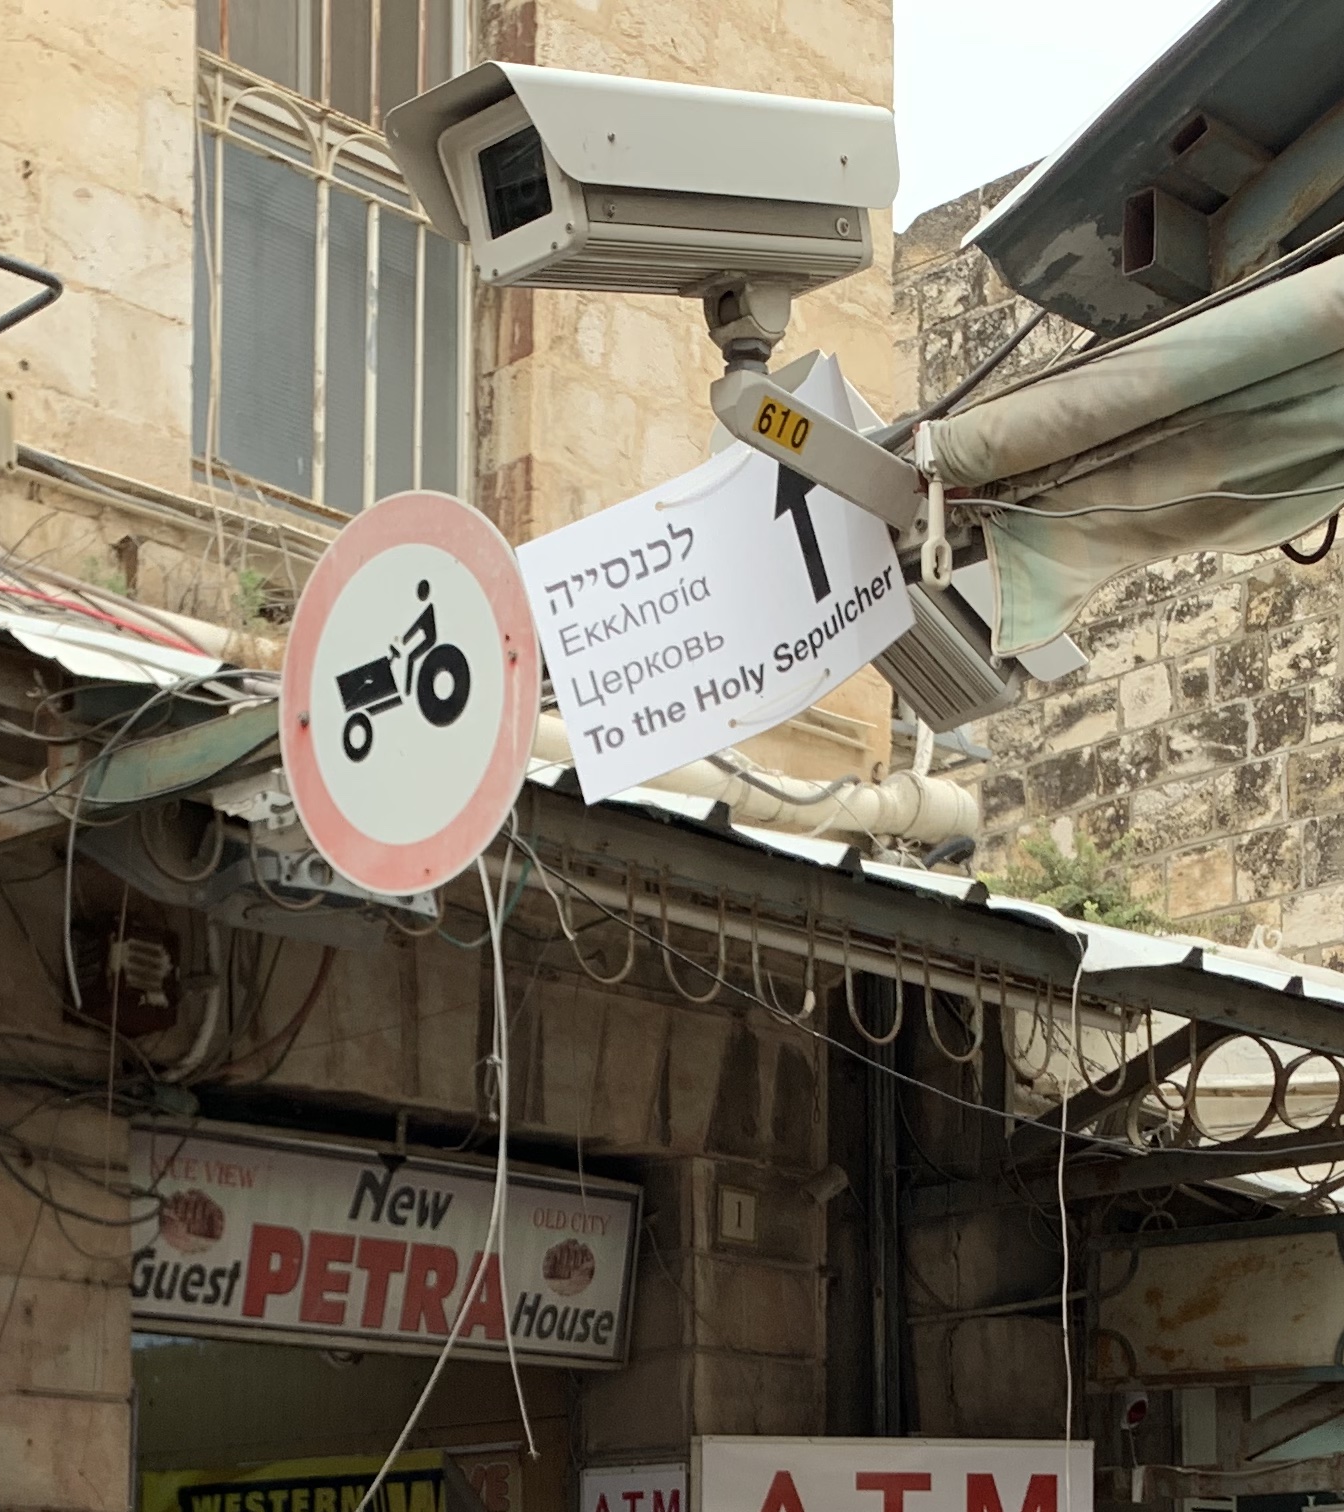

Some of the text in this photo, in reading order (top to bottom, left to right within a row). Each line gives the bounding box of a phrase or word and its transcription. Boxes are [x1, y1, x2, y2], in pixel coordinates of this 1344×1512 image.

[758, 403, 809, 448] 610
[545, 521, 696, 616] לכנסייה
[557, 573, 711, 656] Εκκλησία
[570, 626, 725, 708] Церковь
[584, 565, 895, 756] To the Holy Sepulcher
[349, 1167, 453, 1231] New
[532, 1206, 568, 1231] OLD
[131, 1223, 614, 1346] Guest PETRA House
